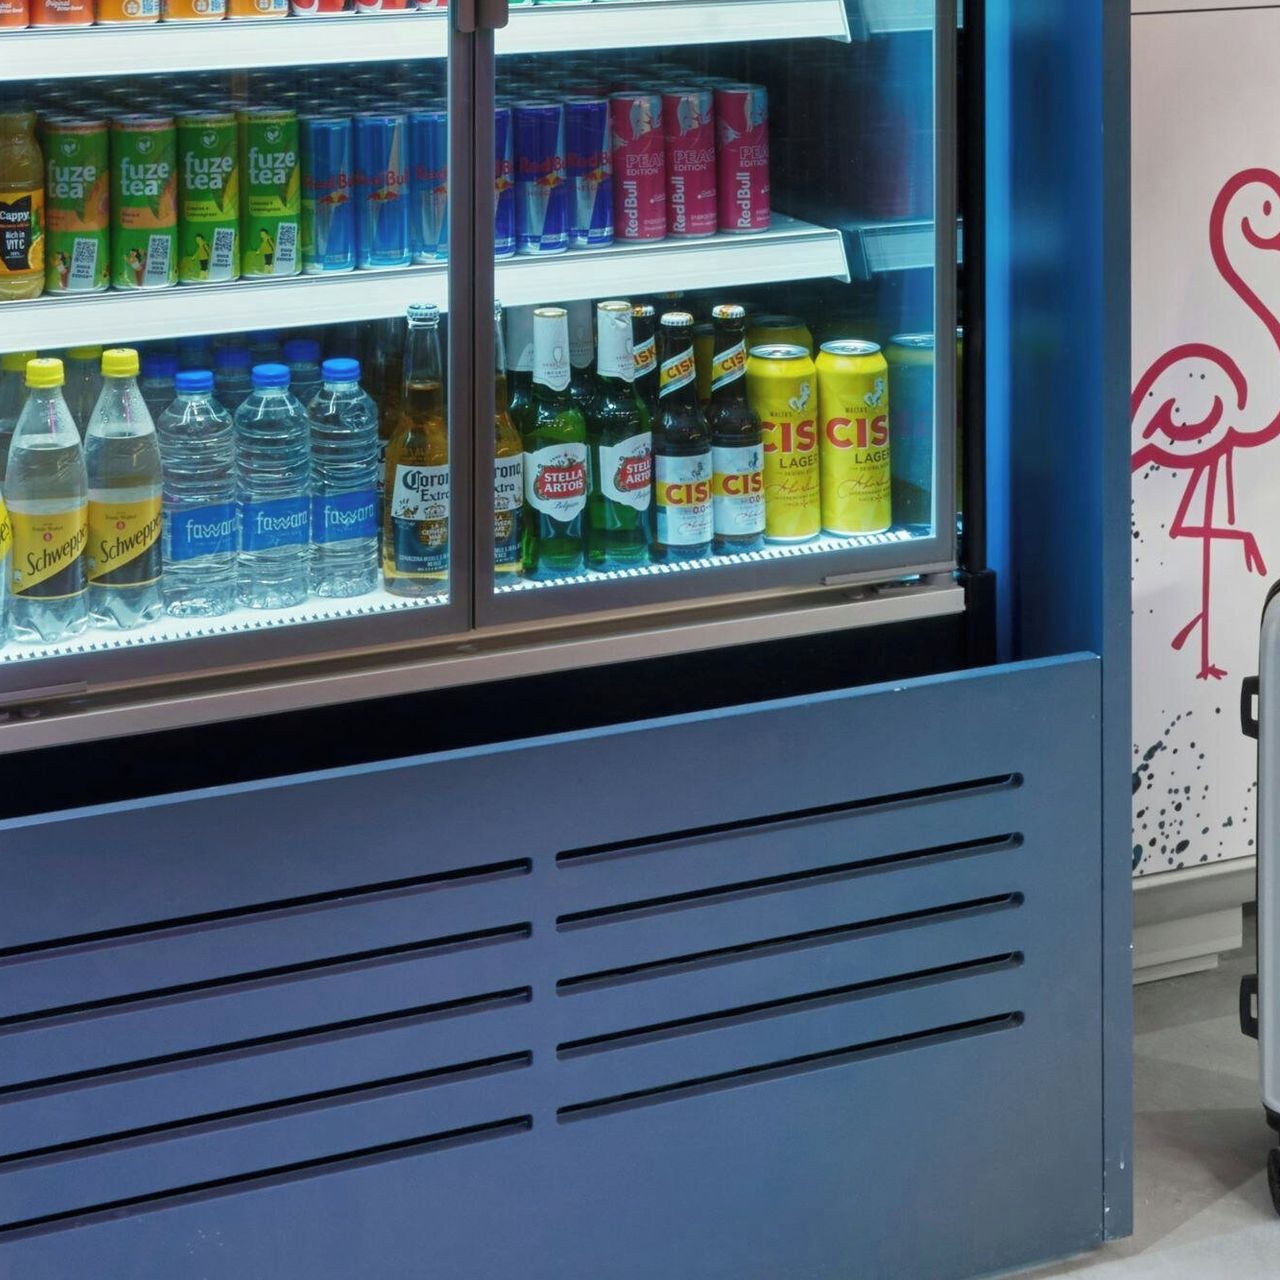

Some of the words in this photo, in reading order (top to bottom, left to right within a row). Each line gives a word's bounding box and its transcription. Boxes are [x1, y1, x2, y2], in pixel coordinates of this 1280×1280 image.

[184, 151, 233, 173] fuze
[248, 146, 295, 169] fuze
[48, 159, 97, 183] fuze
[120, 156, 169, 180] fuze
[248, 167, 286, 185] tea
[626, 167, 659, 176] EDITION
[674, 163, 707, 172] EDITION
[120, 179, 159, 196] tea
[184, 172, 223, 190] tea
[48, 182, 84, 199] tea
[6, 239, 19, 250] VIT
[854, 448, 891, 464] LAGE
[544, 468, 583, 483] STELLA
[544, 478, 584, 493] ARTOIS
